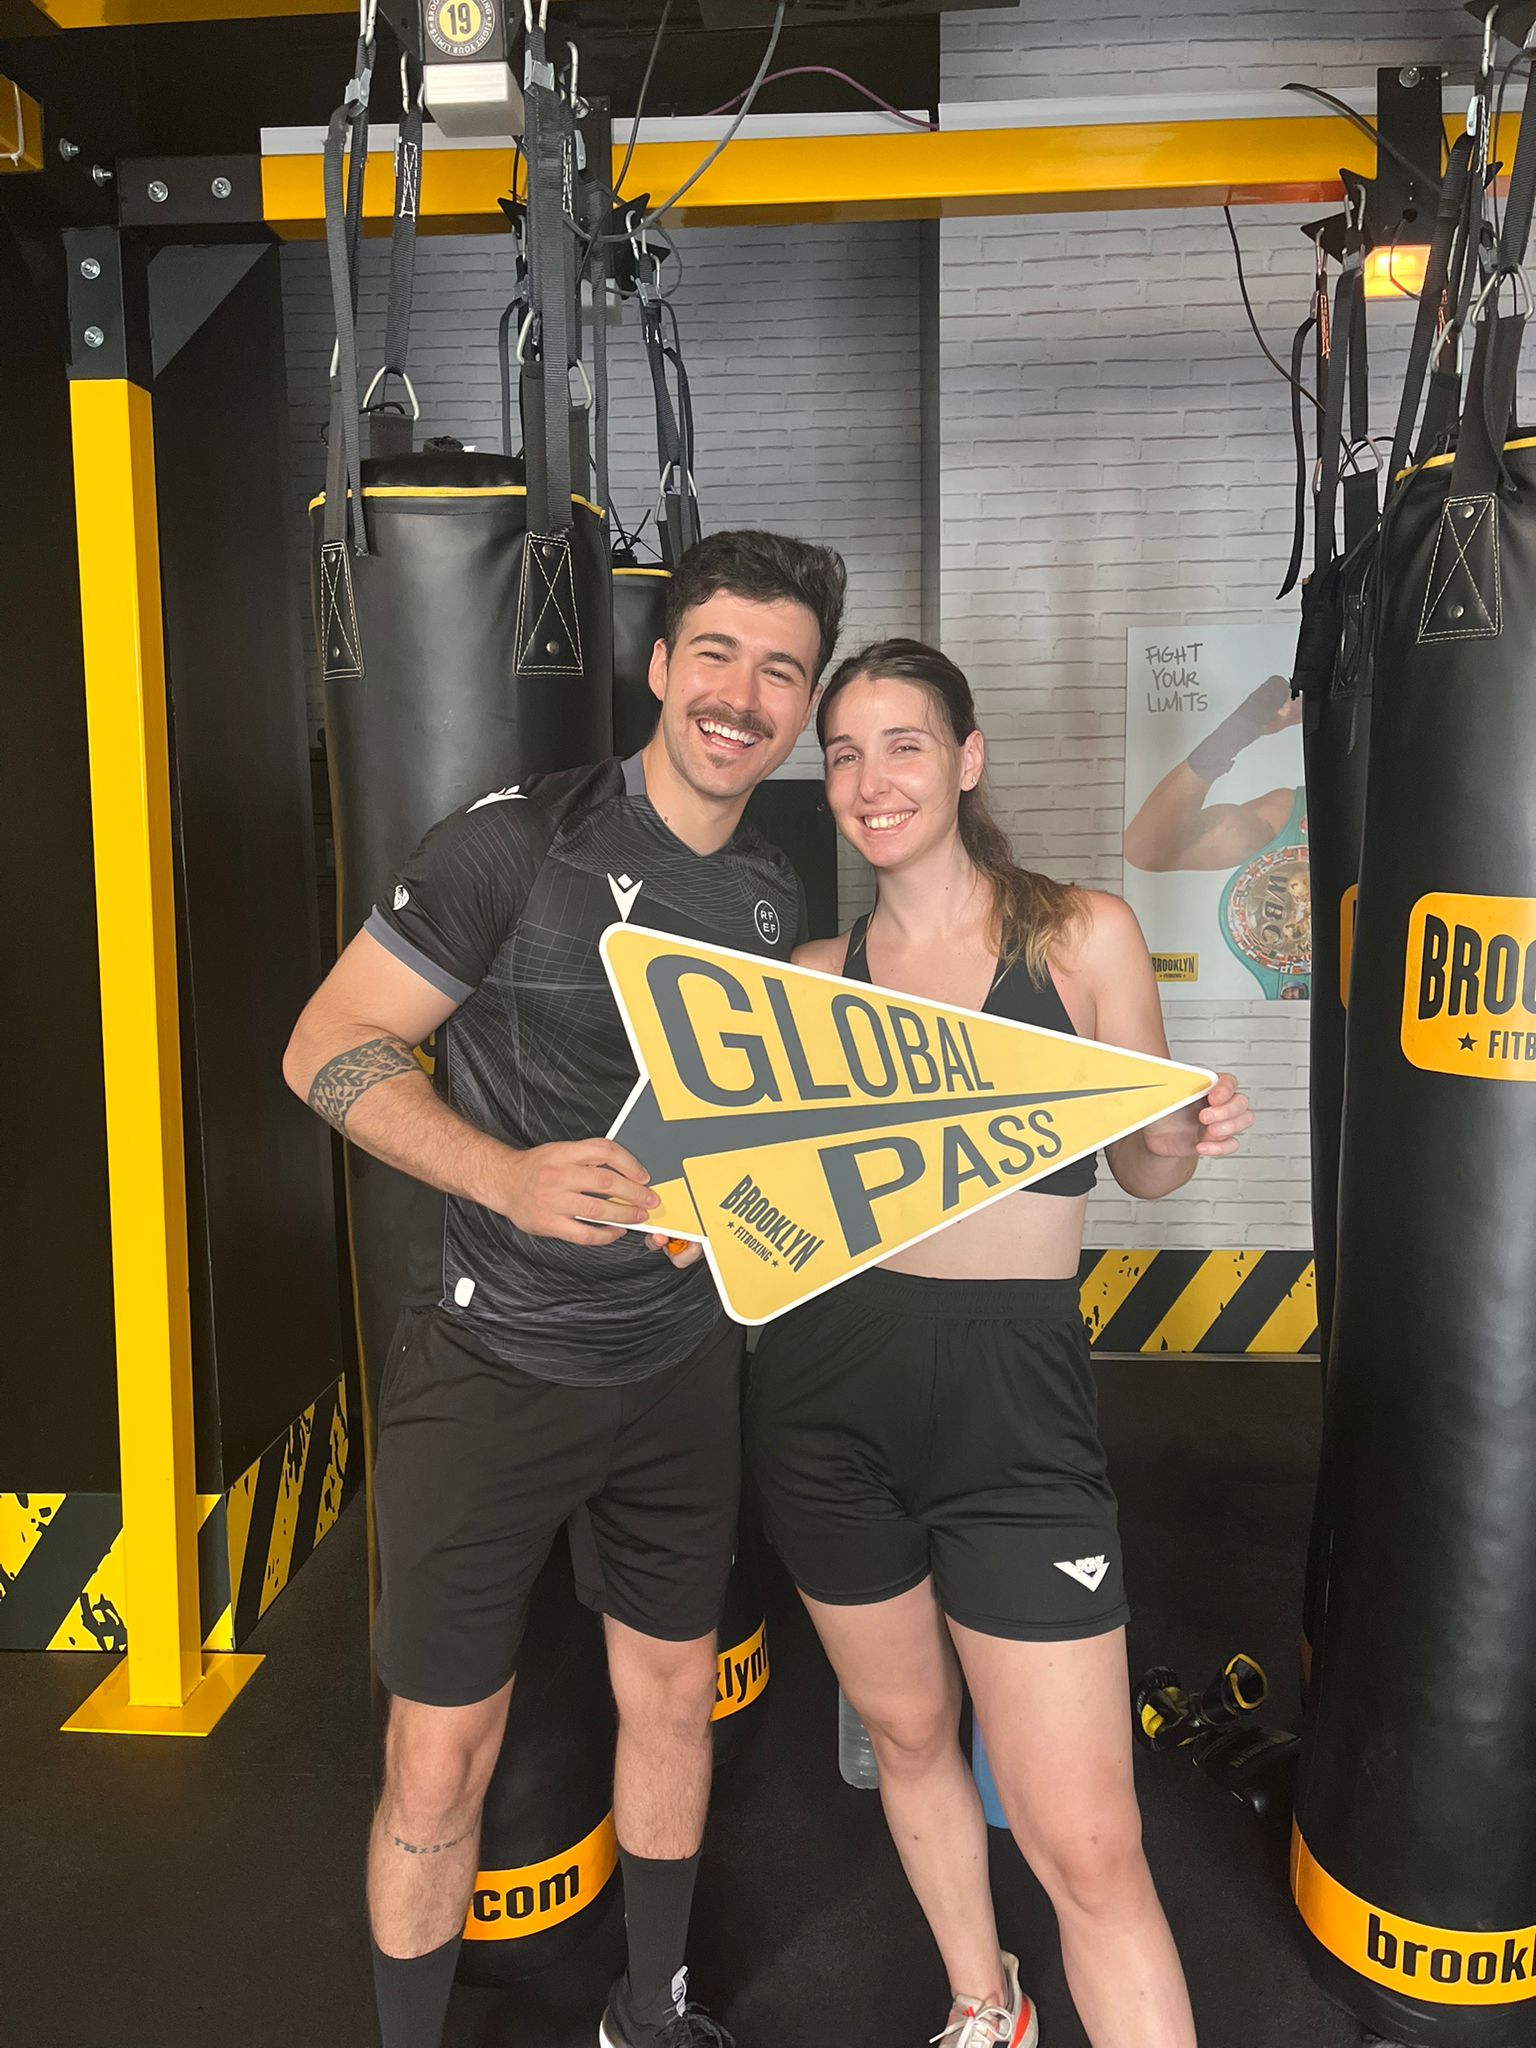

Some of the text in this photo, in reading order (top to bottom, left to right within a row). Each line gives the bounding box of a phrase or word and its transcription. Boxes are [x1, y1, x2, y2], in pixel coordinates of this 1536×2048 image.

[447, 2, 472, 36] 19
[430, 22, 492, 54] FIGHT YOUR LIMITS
[1145, 642, 1203, 665] FIGHT
[1151, 667, 1200, 691] YOUR
[1146, 690, 1208, 713] LIMITS
[1261, 874, 1289, 945] WBC
[646, 954, 996, 1108] GLOBAL
[817, 1109, 1063, 1258] PASS
[719, 1173, 825, 1273] BROOKLYN
[733, 1225, 773, 1262] FITBOXING
